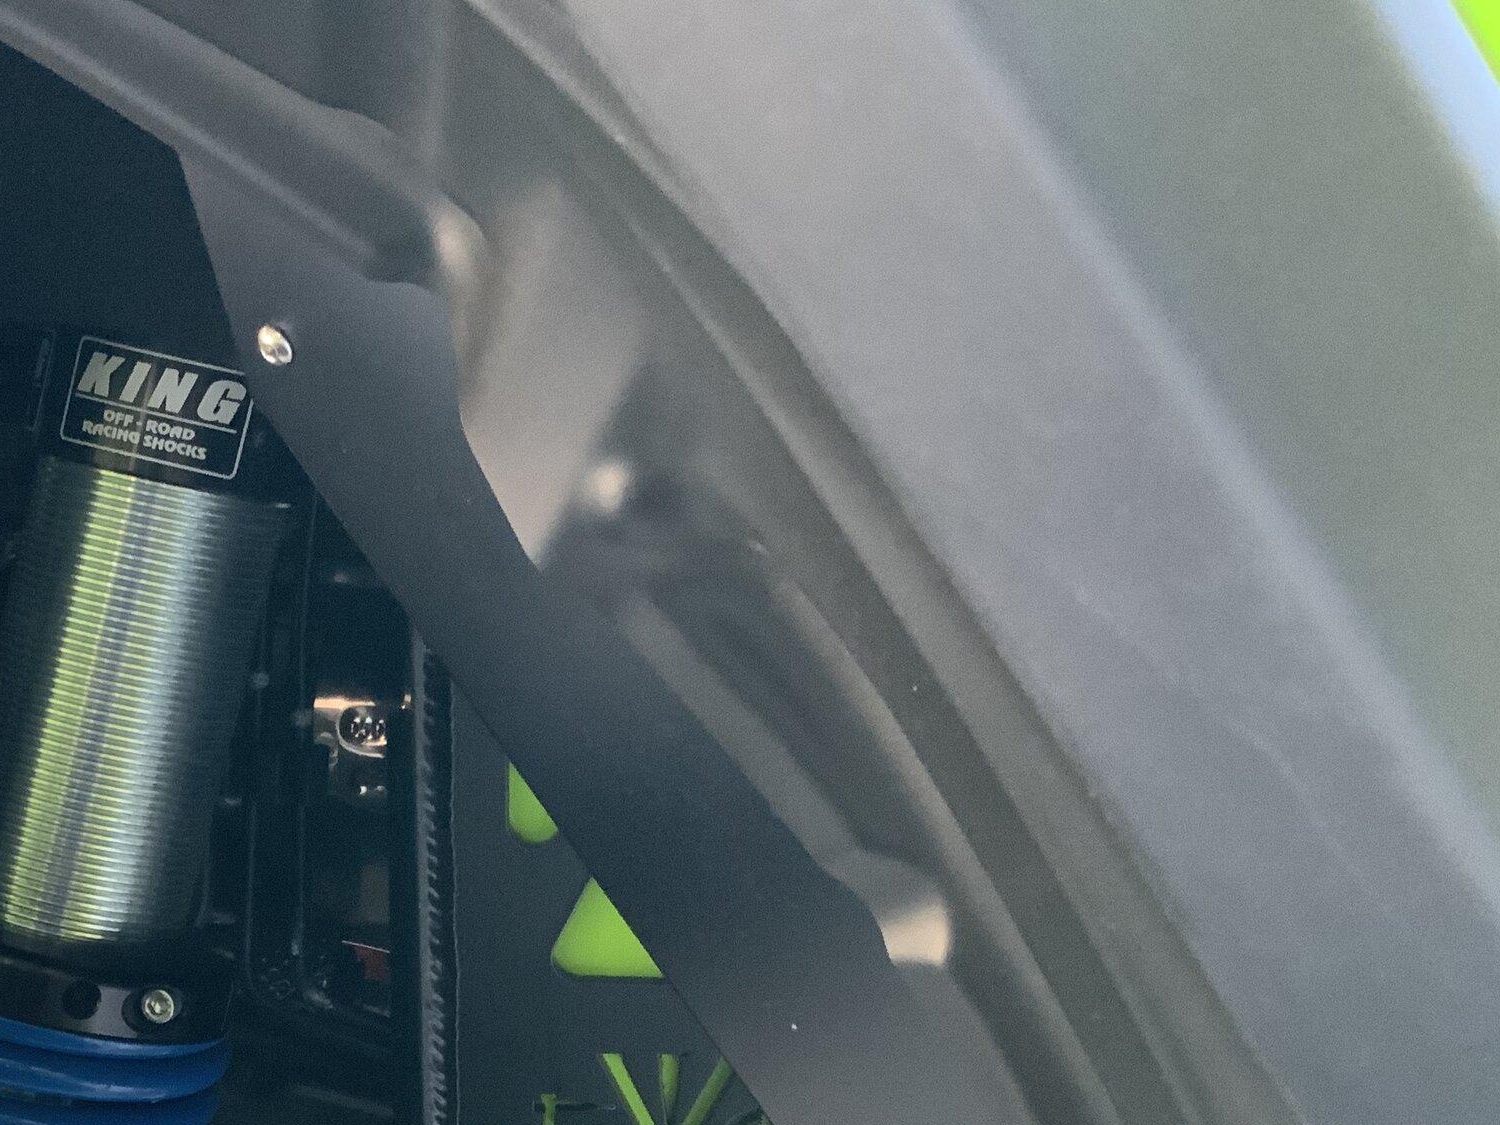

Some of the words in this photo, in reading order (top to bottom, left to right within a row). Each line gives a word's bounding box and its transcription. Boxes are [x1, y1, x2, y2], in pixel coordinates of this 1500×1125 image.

[77, 351, 247, 425] KING
[82, 420, 140, 446] RACING
[143, 434, 207, 461] SHOCKS
